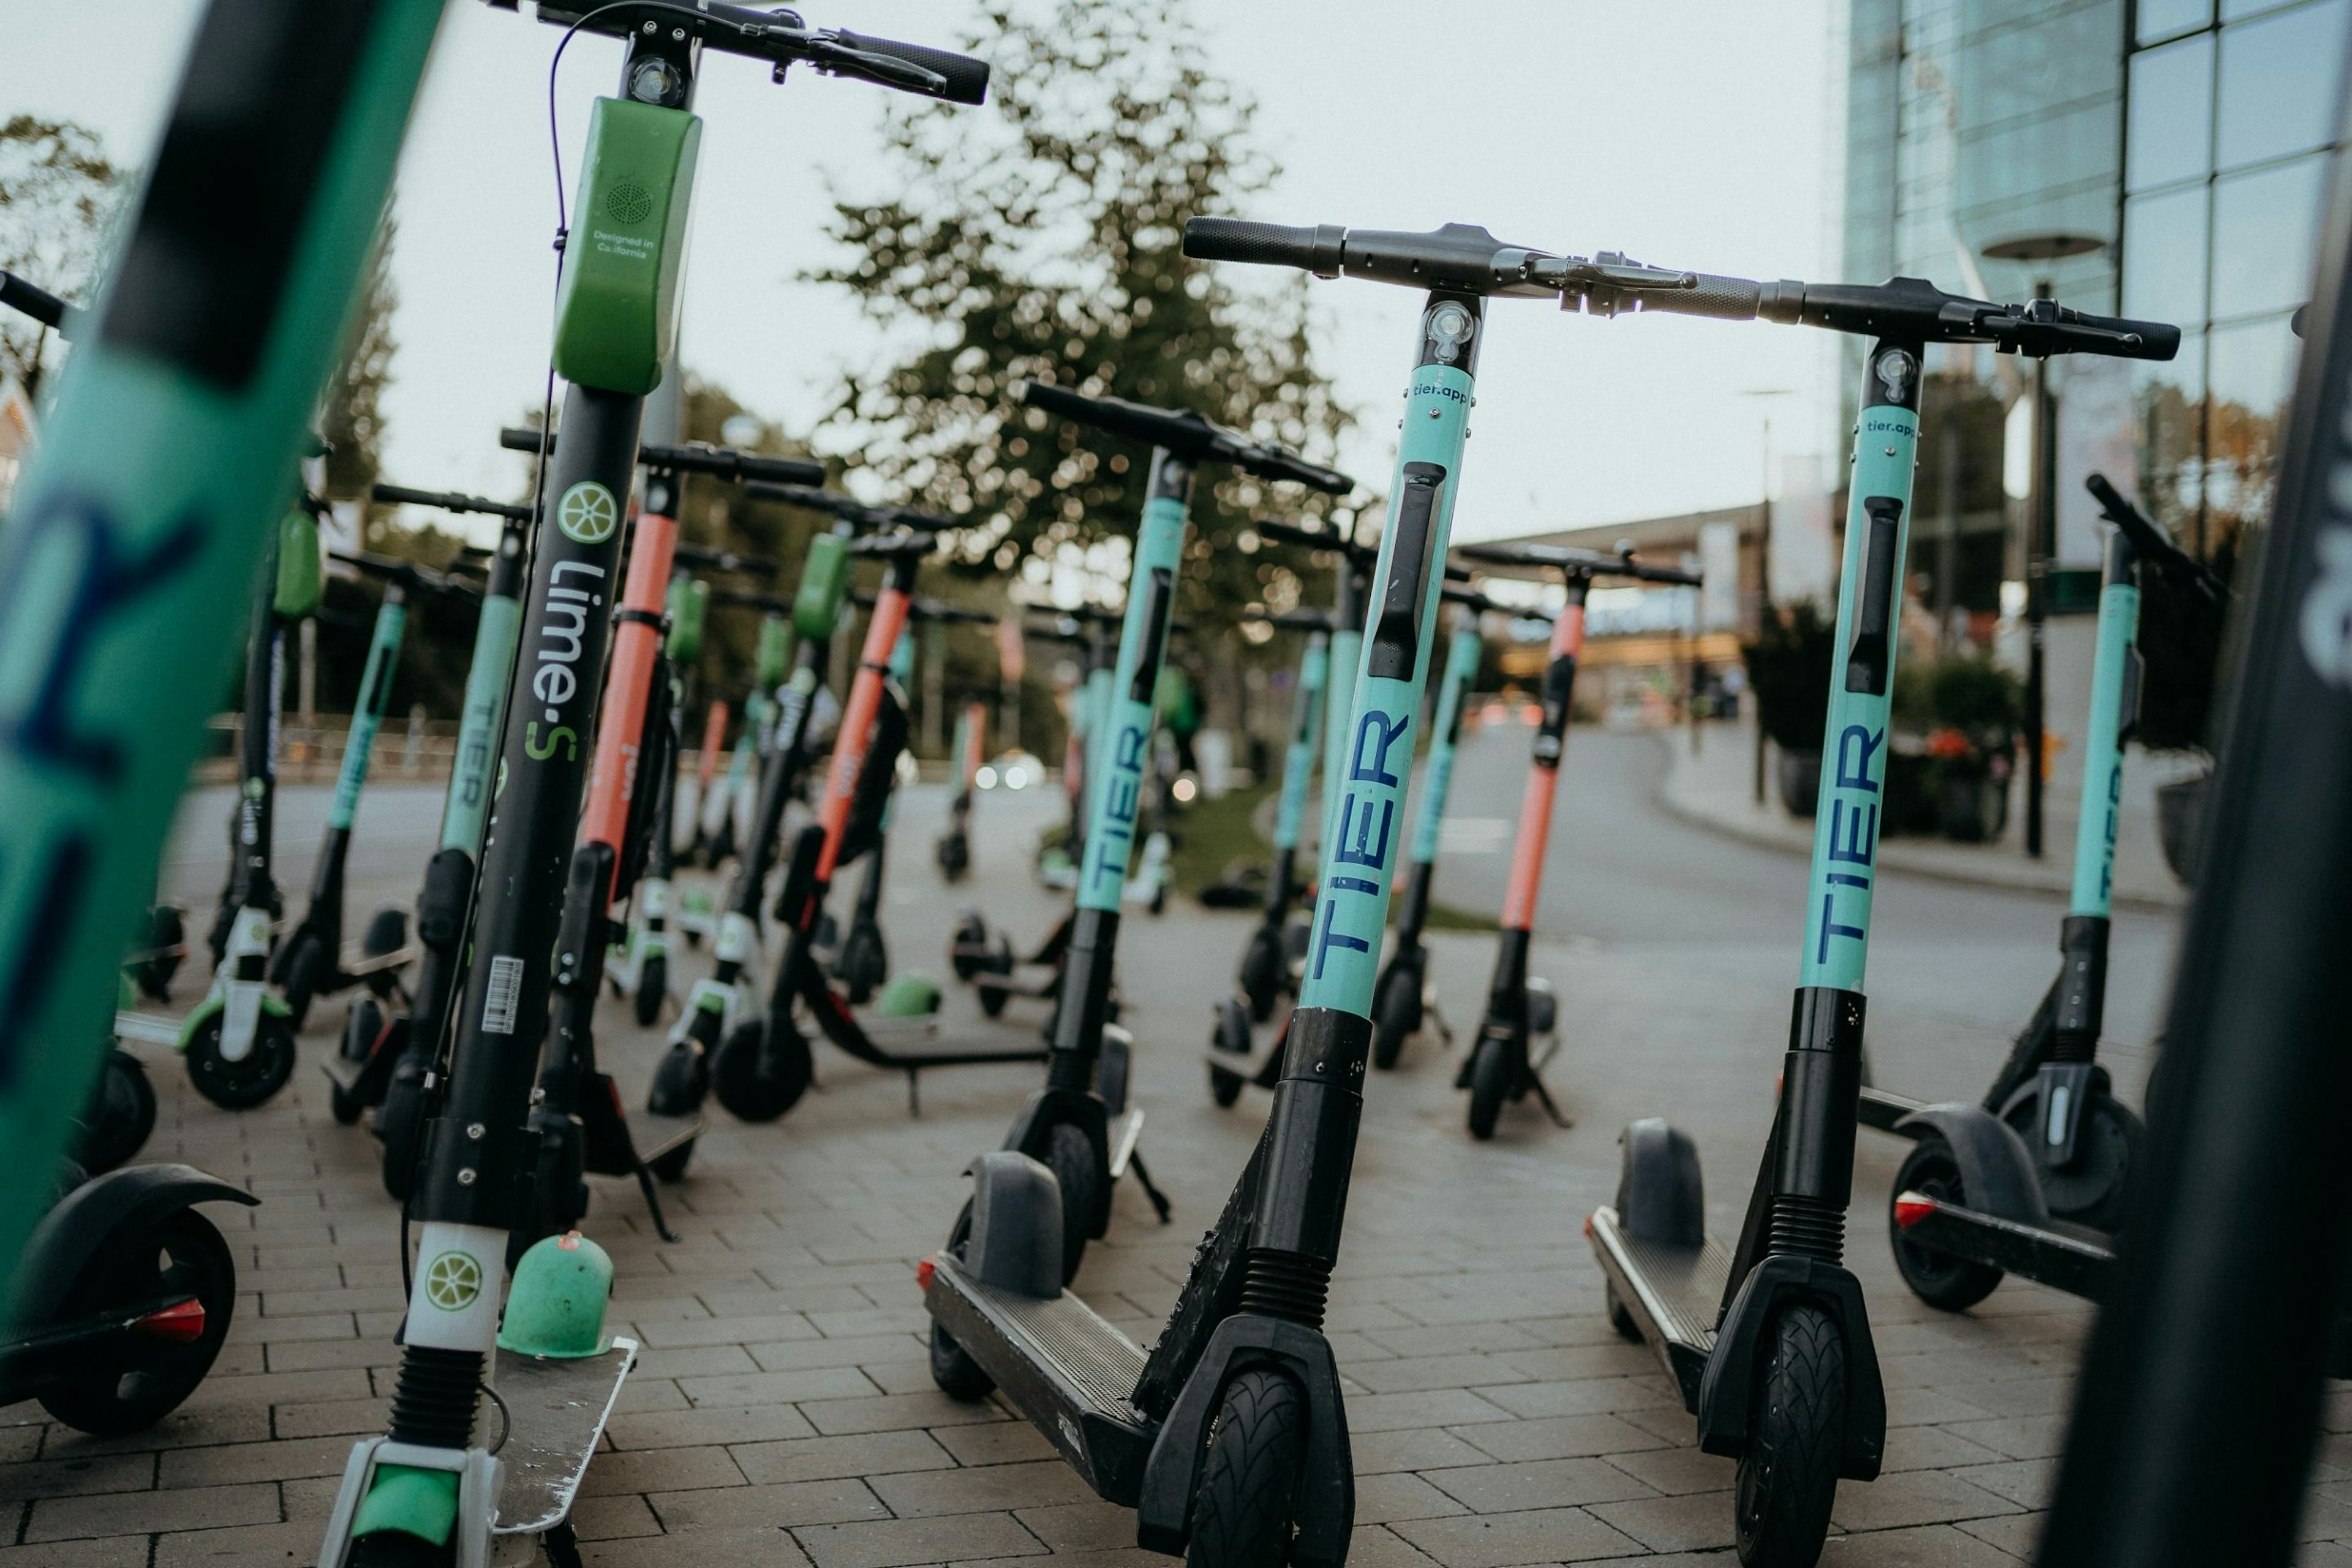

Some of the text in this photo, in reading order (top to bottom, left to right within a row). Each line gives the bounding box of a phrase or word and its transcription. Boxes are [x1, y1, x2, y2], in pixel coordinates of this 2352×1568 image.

[594, 230, 654, 249] Designed in
[597, 243, 647, 258] Caifornia
[1413, 383, 1467, 404] tier.app
[1868, 420, 1915, 438] tier.app
[1094, 726, 1148, 891] TIER
[1313, 710, 1409, 979] TIER
[1817, 725, 1884, 965] TIER
